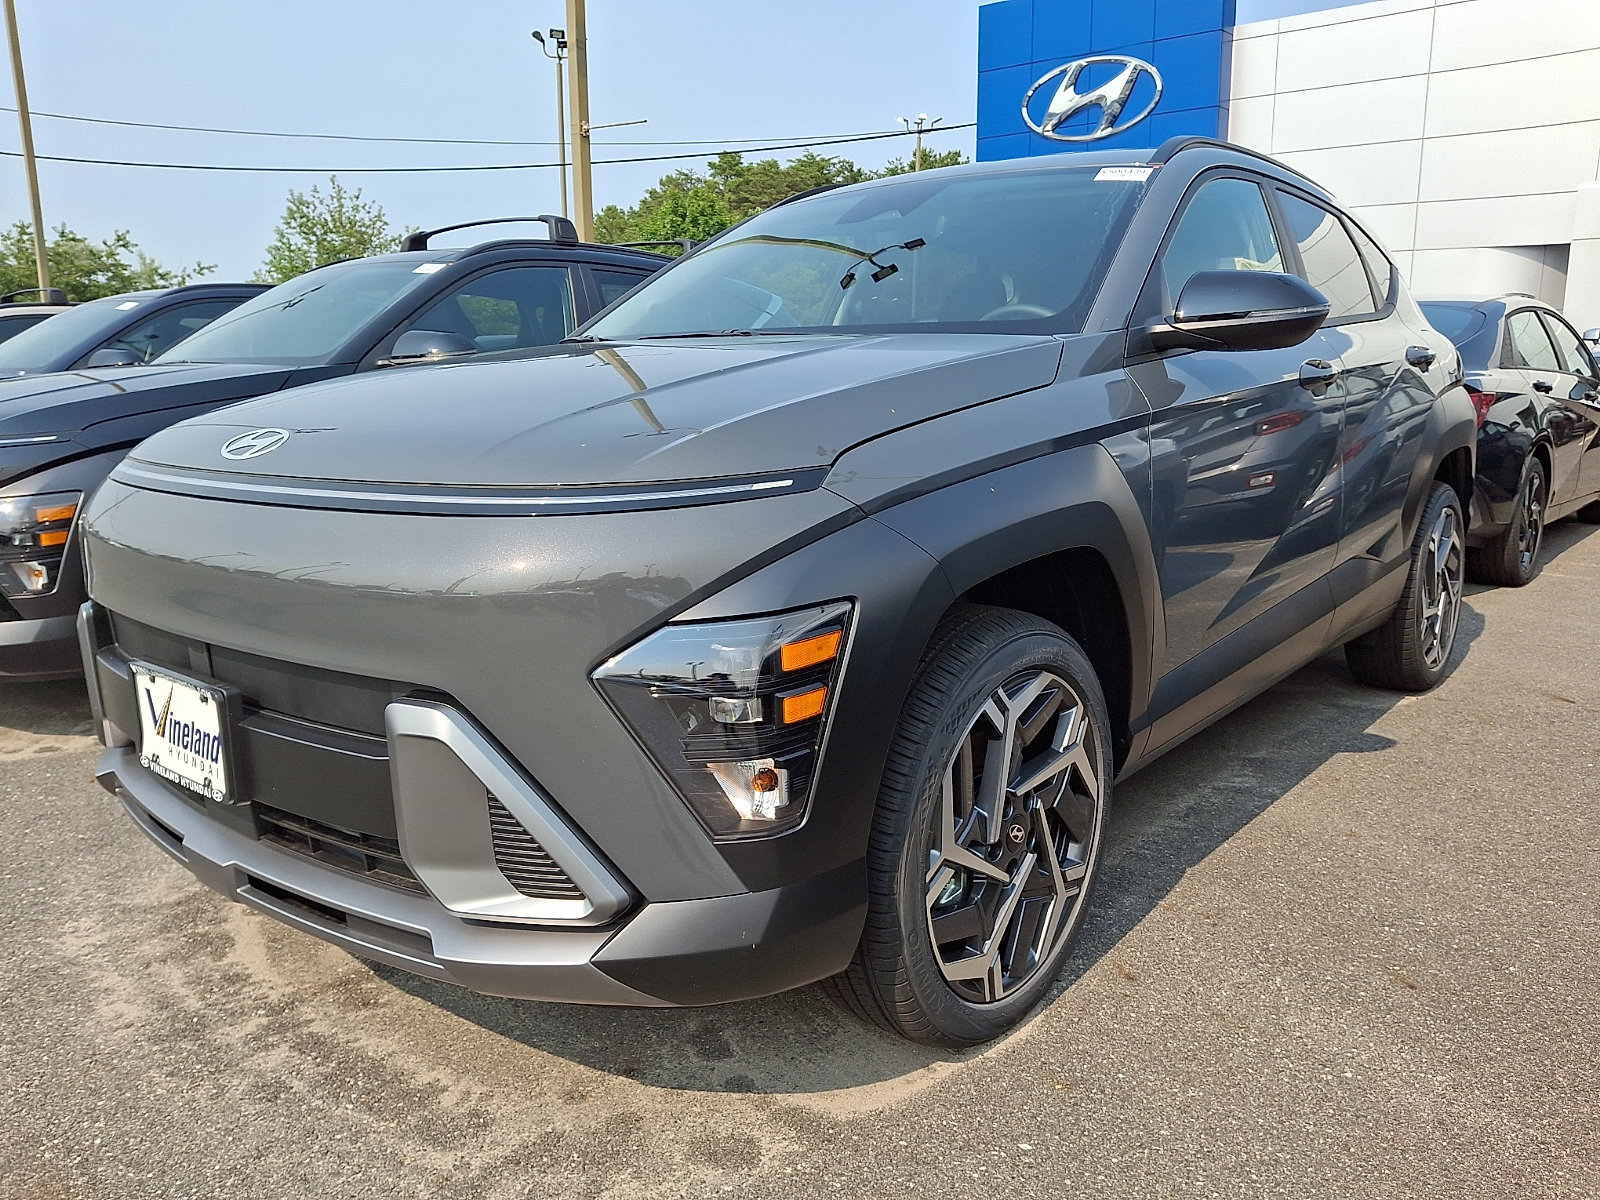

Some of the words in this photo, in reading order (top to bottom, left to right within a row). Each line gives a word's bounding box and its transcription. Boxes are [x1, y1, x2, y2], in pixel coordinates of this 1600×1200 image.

[145, 682, 223, 764] Vineland
[149, 761, 180, 783] VINELAND
[180, 776, 212, 799] HYUNDAI
[168, 746, 220, 779] HYUNDAI
